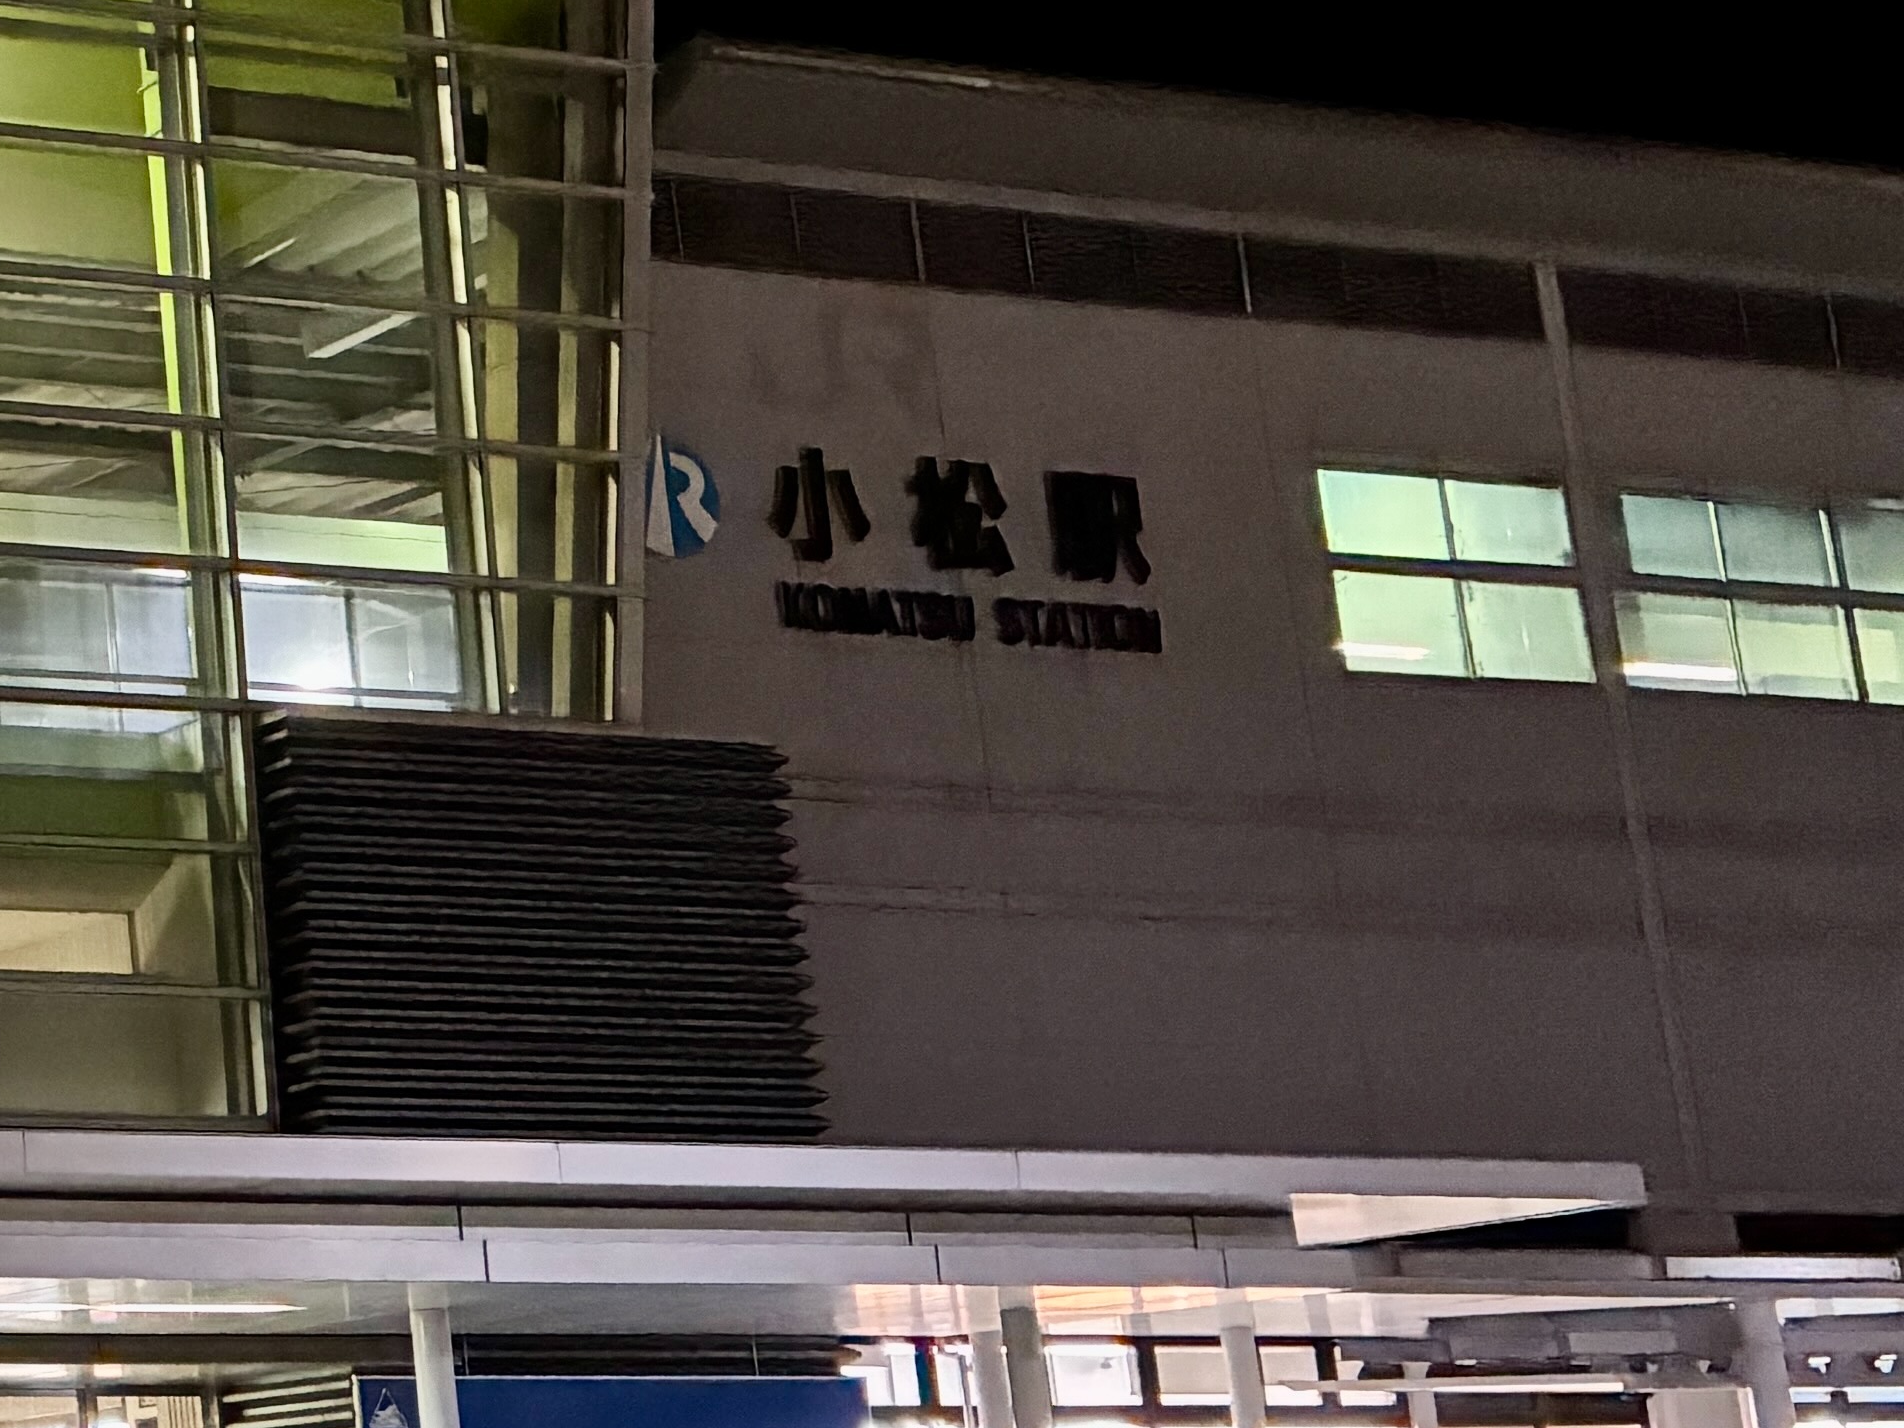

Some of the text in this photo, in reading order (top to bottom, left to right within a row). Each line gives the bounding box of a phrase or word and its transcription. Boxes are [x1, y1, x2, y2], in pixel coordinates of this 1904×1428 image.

[766, 446, 1153, 586] 小松駅
[775, 579, 1164, 655] KOMATSU STATION
